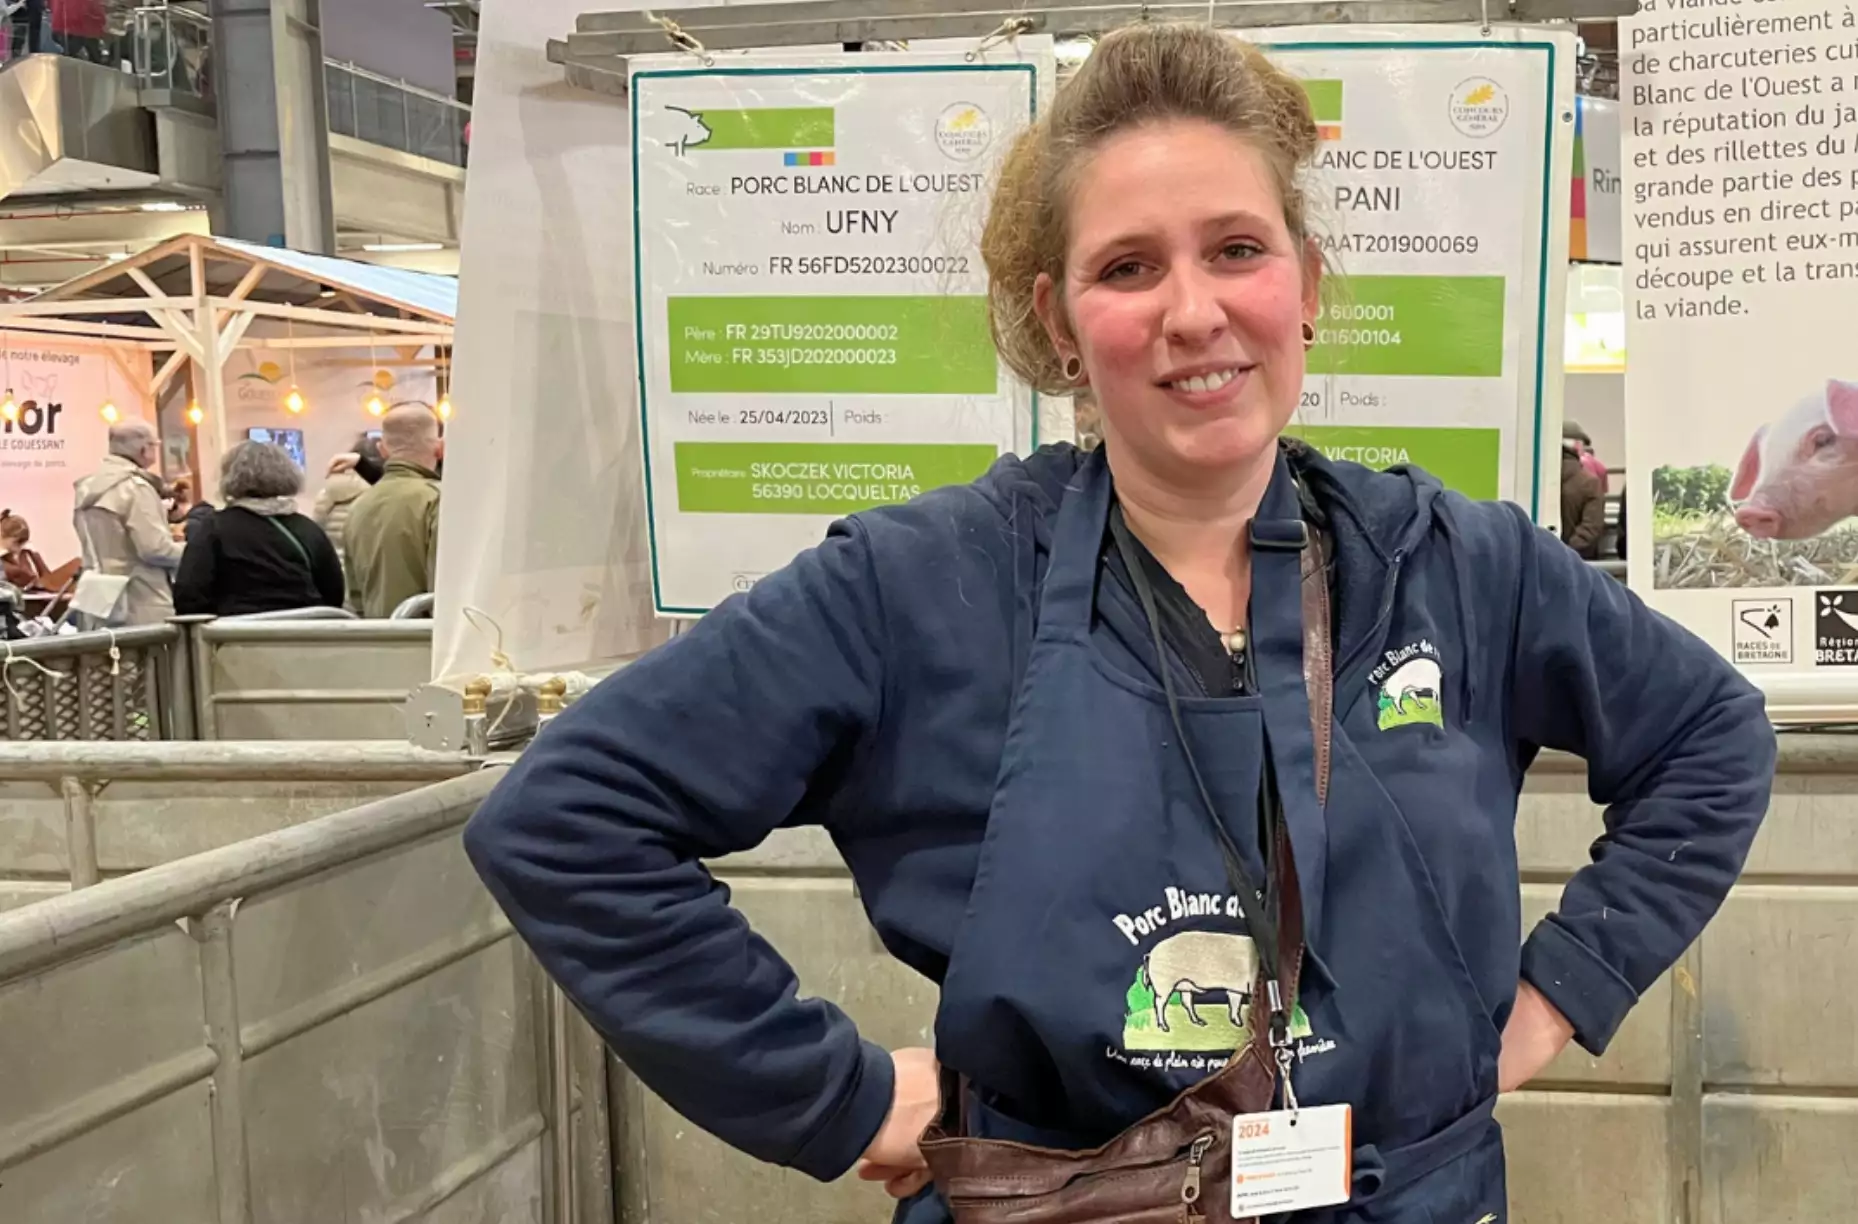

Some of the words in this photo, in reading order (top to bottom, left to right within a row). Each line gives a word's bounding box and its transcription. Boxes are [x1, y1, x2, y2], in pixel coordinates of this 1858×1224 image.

[1666, 0, 1741, 9] via
[1632, 10, 1832, 49] particulièrement
[1842, 5, 1856, 28] à
[1632, 53, 1660, 75] de
[1669, 44, 1816, 72] charcuteries
[1633, 84, 1696, 106] Blanc
[1704, 79, 1733, 102] de
[1742, 75, 1822, 98] l'Ouest
[1831, 77, 1844, 92] a
[1634, 116, 1653, 137] la
[1663, 110, 1787, 138] réputation
[1796, 104, 1825, 126] du
[1373, 151, 1402, 170] DE
[1409, 151, 1497, 170] L'OUEST
[1634, 149, 1658, 167] et
[1666, 144, 1705, 165] des
[1714, 140, 1808, 163] rillettes
[1816, 135, 1845, 156] du
[687, 183, 720, 196] Race
[731, 176, 788, 195] PORC
[795, 175, 861, 194] BLANC
[866, 174, 894, 193] DE
[900, 173, 984, 193] L'OUEST
[1634, 174, 1714, 204] grande
[1723, 169, 1793, 196] partie
[1802, 167, 1841, 188] des
[1335, 187, 1400, 211] PANI
[781, 222, 814, 235] Nom
[826, 210, 898, 235] UFNY
[1634, 206, 1715, 229] vendus
[1724, 205, 1751, 223] en
[1760, 199, 1831, 222] direct
[1636, 238, 1670, 264] qui
[1679, 232, 1777, 257] assurent
[703, 261, 759, 277] Numéro
[769, 257, 793, 275] FR
[798, 257, 969, 275] 56FD5202300022
[1636, 267, 1733, 291] découpe
[1742, 265, 1766, 284] et
[1776, 261, 1796, 282] la
[1637, 299, 1656, 321] la
[1664, 295, 1750, 319] viande.
[685, 326, 715, 342] Père
[726, 325, 746, 340] FR
[750, 324, 898, 341] 29TU9202000002
[685, 351, 723, 365] Mère
[733, 350, 753, 365] FR
[757, 348, 897, 368] 353JD202000023
[1340, 391, 1379, 407] Poids
[688, 410, 715, 425] Née
[718, 410, 731, 424] le
[739, 410, 828, 426] 25/04/2023
[844, 410, 882, 424] Poids
[10, 440, 65, 450] GOUESSANT
[1325, 446, 1410, 463] VICTORIA
[751, 462, 831, 480] SKOCZEK
[832, 463, 915, 480] VICTORIA
[752, 483, 802, 499] 56390
[807, 484, 921, 500] LOCQUELTAS
[1384, 642, 1420, 666] Blanc
[1737, 641, 1768, 651] RACES
[1738, 651, 1788, 660] BRETAGNE
[1112, 904, 1167, 946] Porc
[1164, 886, 1221, 920] Blanc
[1164, 1050, 1188, 1072] plein
[1238, 1124, 1269, 1139] 2024
